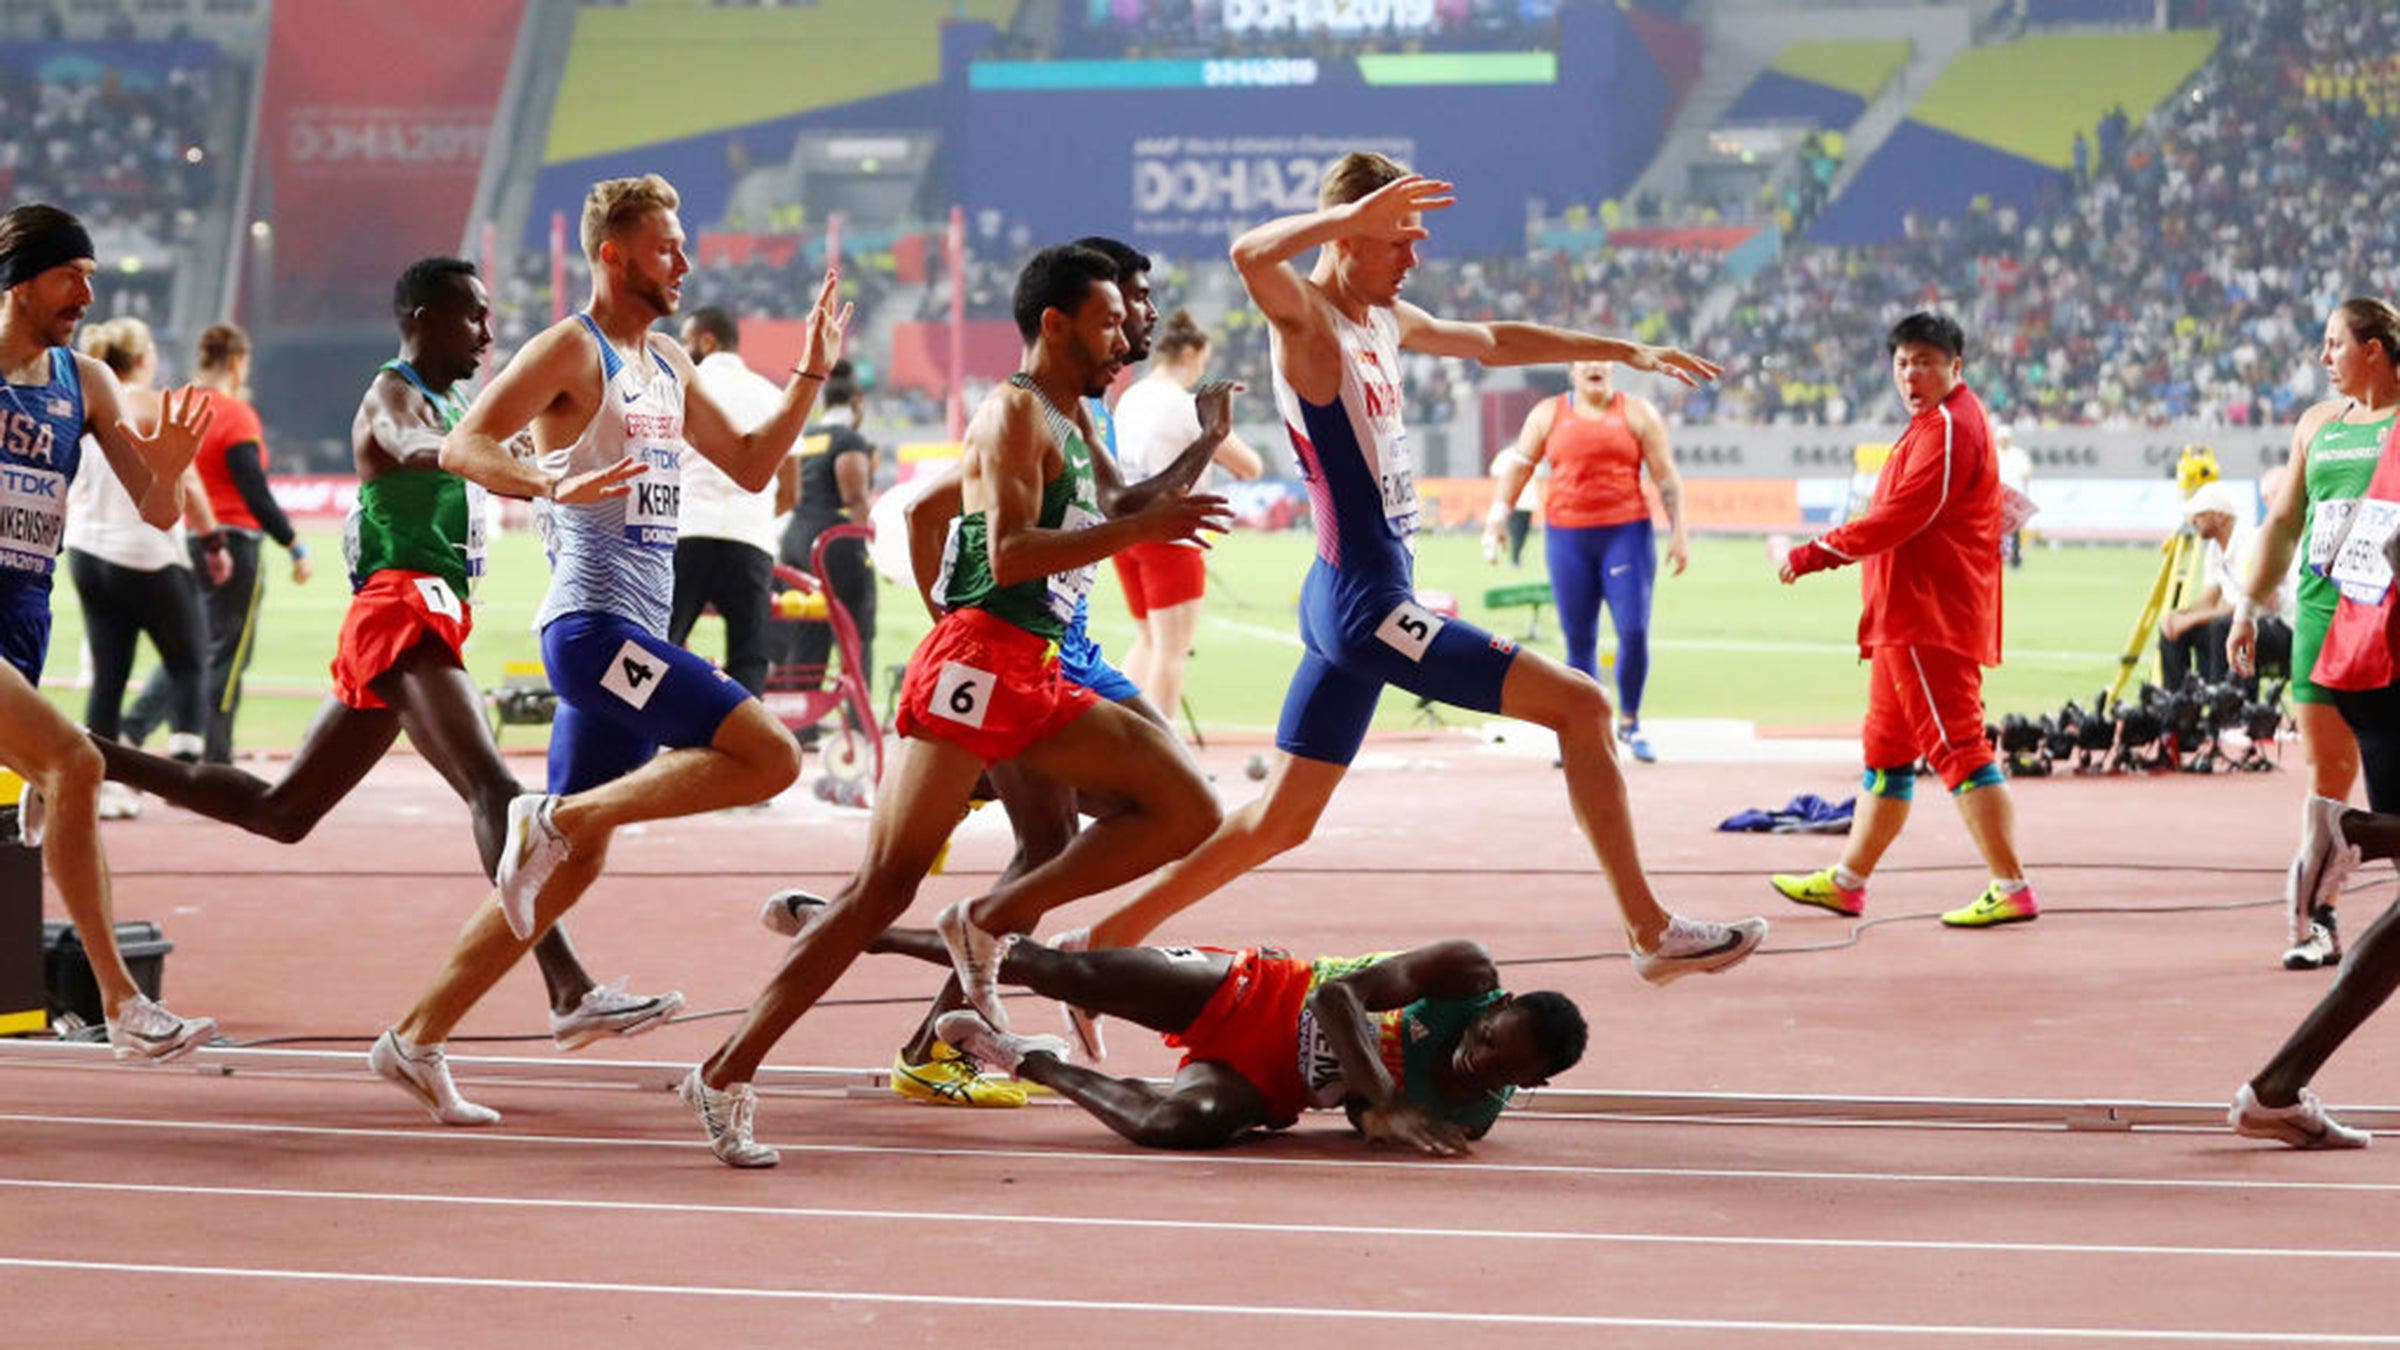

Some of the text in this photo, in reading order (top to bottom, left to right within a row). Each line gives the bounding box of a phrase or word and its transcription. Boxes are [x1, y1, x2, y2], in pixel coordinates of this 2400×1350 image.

[650, 450, 681, 470] TDK
[3, 470, 58, 498] TDK
[431, 585, 446, 608] 1
[1397, 614, 1428, 641] 5
[623, 656, 654, 689] 4
[950, 680, 976, 714] 6
